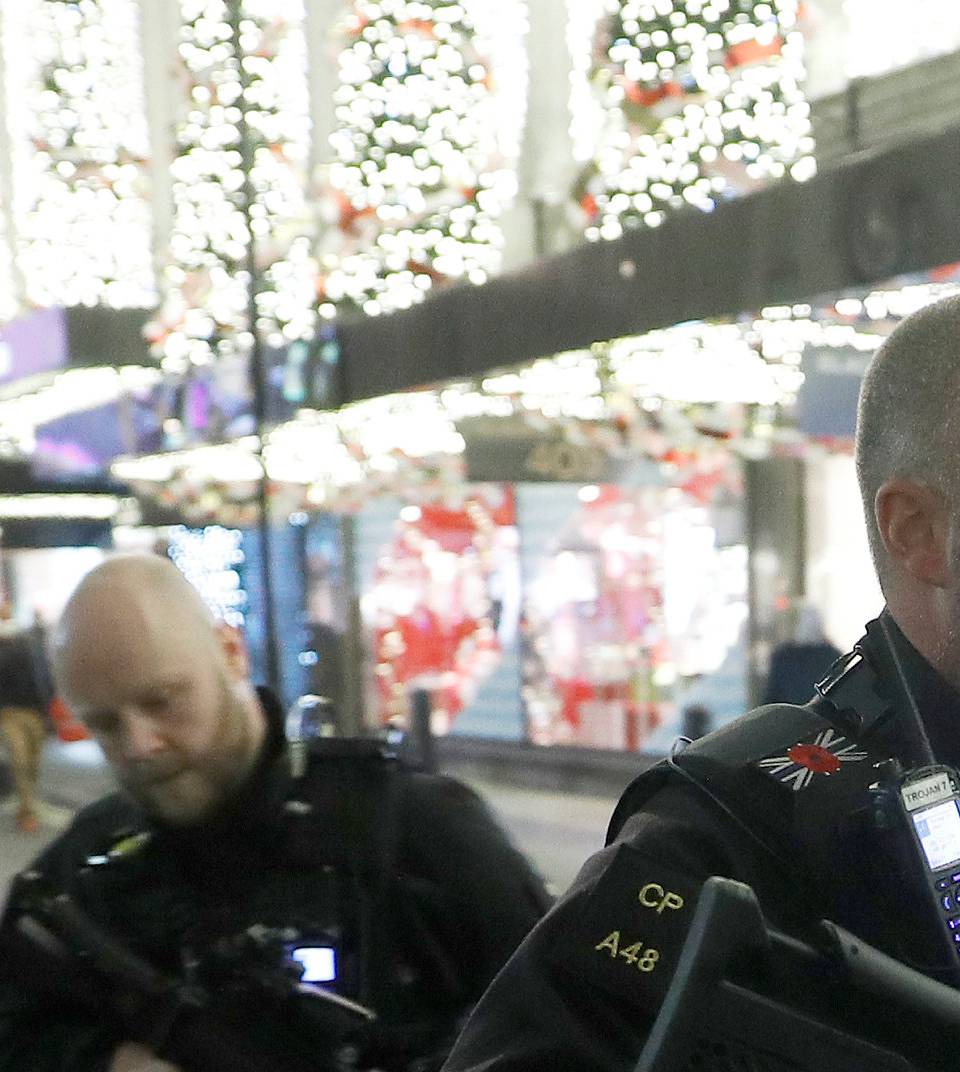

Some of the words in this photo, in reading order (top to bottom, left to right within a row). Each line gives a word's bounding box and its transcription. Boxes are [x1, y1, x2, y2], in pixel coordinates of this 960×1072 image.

[905, 783, 941, 802] TROJAN
[639, 882, 684, 914] CP
[595, 930, 660, 972] A48
